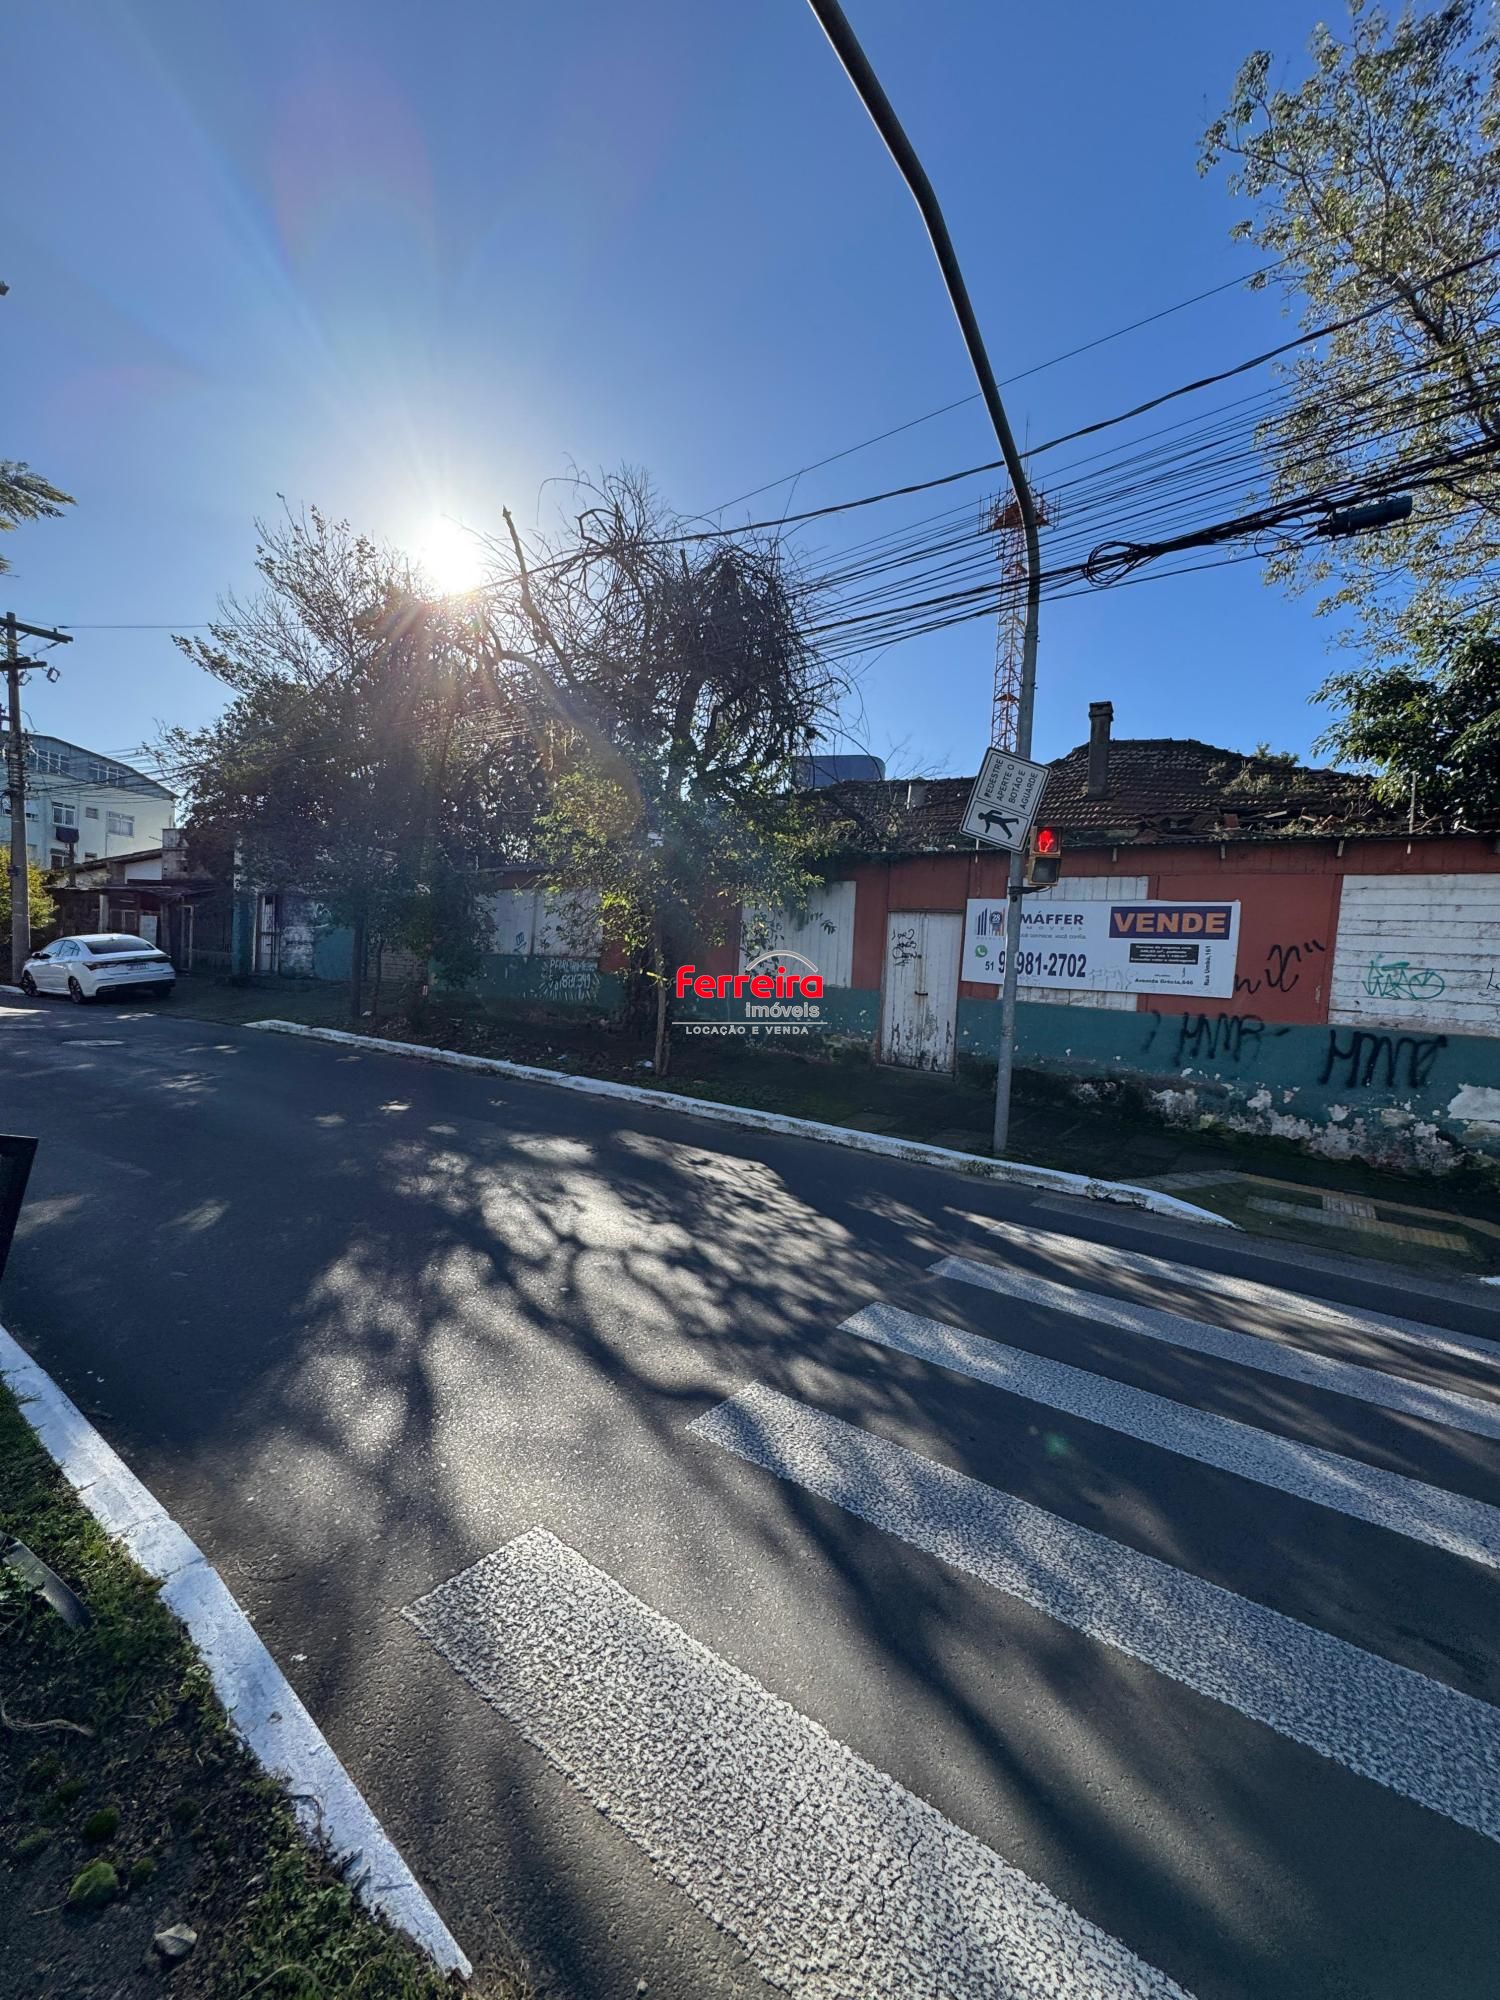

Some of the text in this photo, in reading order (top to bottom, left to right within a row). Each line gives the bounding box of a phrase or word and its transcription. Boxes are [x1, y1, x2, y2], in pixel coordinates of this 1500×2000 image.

[984, 758, 1004, 798] PEDESTRE
[996, 771, 1012, 801] APERTE
[1008, 769, 1026, 804] BOTÃO E
[1019, 772, 1038, 810] AGUARDE
[1020, 910, 1084, 925] MÁFFER
[1113, 912, 1227, 933] VENDE
[985, 961, 994, 971] 51
[998, 950, 1087, 978] 9981-2702
